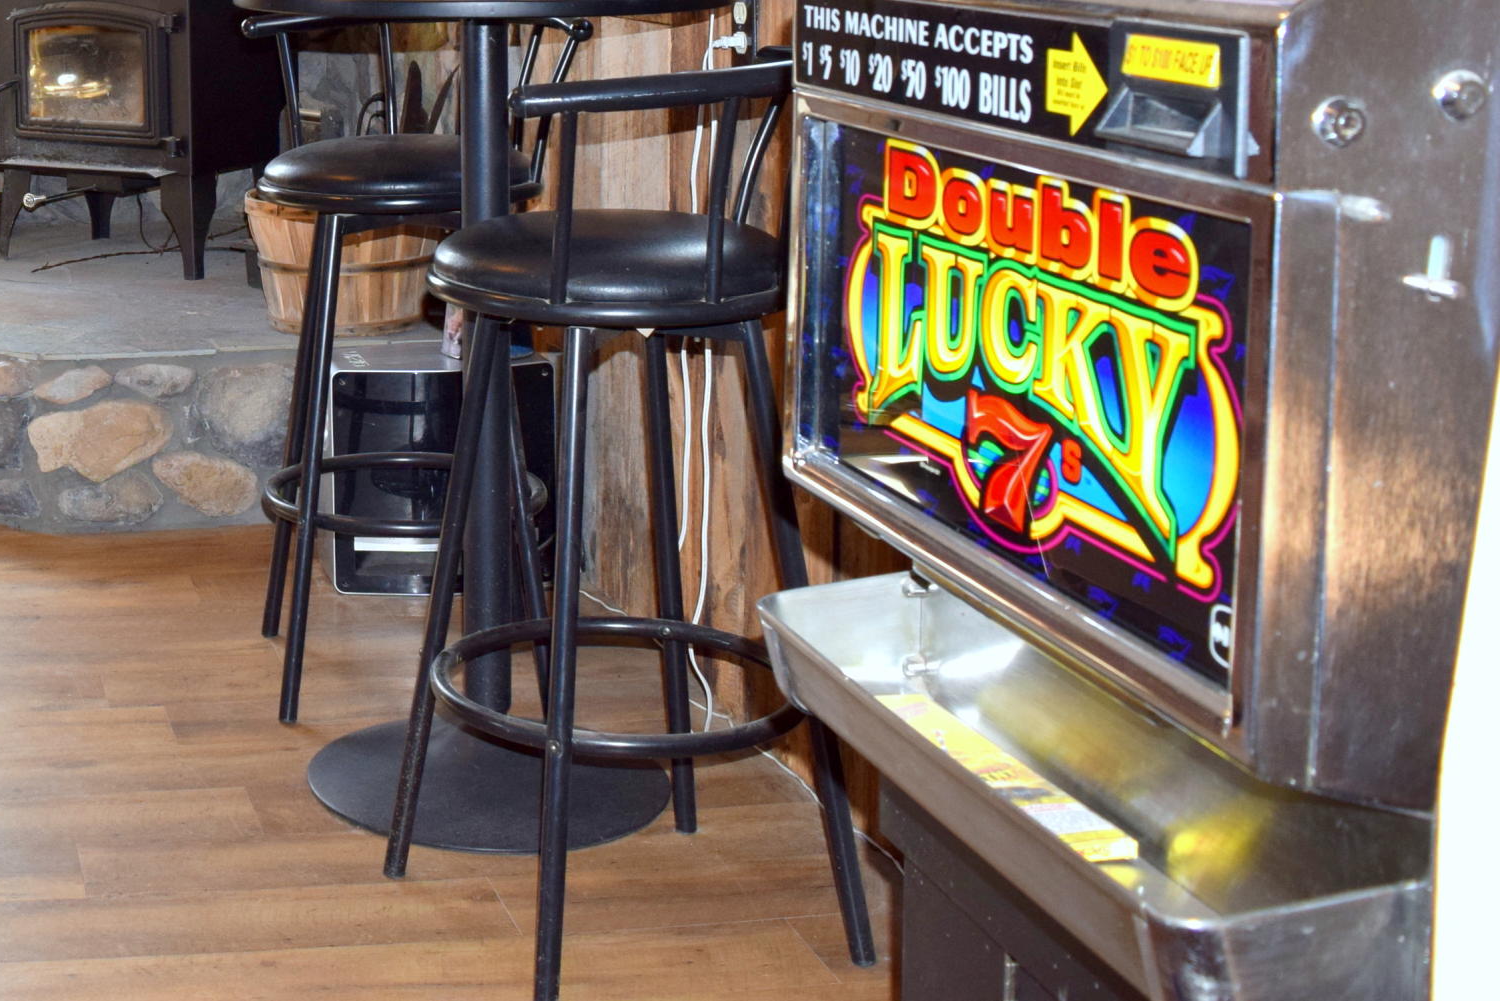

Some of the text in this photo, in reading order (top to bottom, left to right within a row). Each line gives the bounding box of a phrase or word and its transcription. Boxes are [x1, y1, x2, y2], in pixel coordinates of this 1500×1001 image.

[802, 41, 813, 76] $1
[820, 45, 833, 80] $5
[840, 48, 861, 87] $10
[868, 52, 893, 94] $20
[901, 58, 927, 100] $50
[935, 65, 971, 110] $100
[978, 72, 1032, 124] BILLS
[804, 4, 1034, 65] THIS MACHINE ACCEPTS
[884, 139, 1198, 312] Double
[869, 217, 1198, 562] LUCKY
